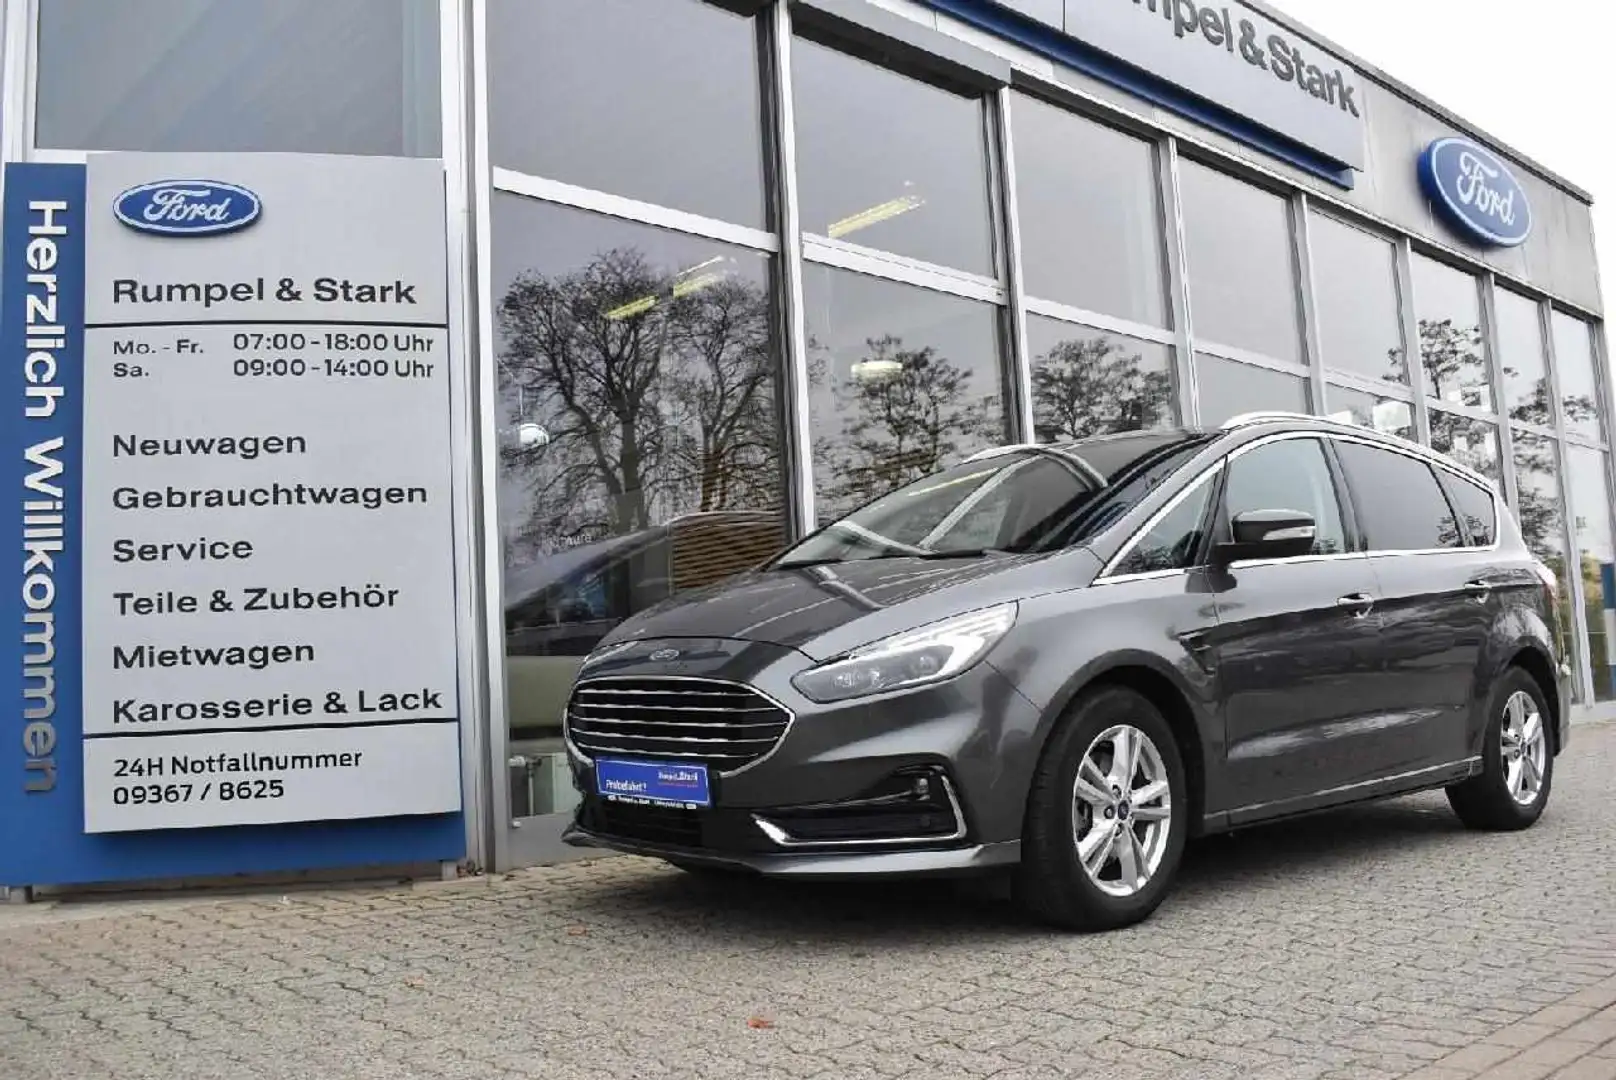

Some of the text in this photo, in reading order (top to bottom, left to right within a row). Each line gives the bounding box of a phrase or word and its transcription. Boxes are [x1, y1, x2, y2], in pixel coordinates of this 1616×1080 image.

[1239, 18, 1268, 70] &
[1267, 34, 1360, 118] Stark
[1456, 151, 1516, 226] Ford
[143, 189, 232, 221] Ford
[113, 277, 417, 308] Rumpel & Stark
[113, 340, 156, 355] Mo.
[176, 338, 204, 354] Fr.
[393, 333, 434, 352] Uhr
[113, 362, 149, 378] Sa.
[394, 359, 434, 378] Uhr
[113, 434, 306, 460] Neuwagen
[23, 200, 67, 791] Herzlich Willkommen
[112, 483, 427, 510] Gebrauchtwagen
[113, 537, 254, 563] Service
[113, 583, 399, 616] Teile & Zubehör
[113, 641, 314, 670] Mietwagen
[113, 688, 443, 724] Karosserie & Lack
[113, 750, 363, 778] 24H Notfallnummer
[113, 784, 193, 805] 09367
[199, 782, 212, 802] /
